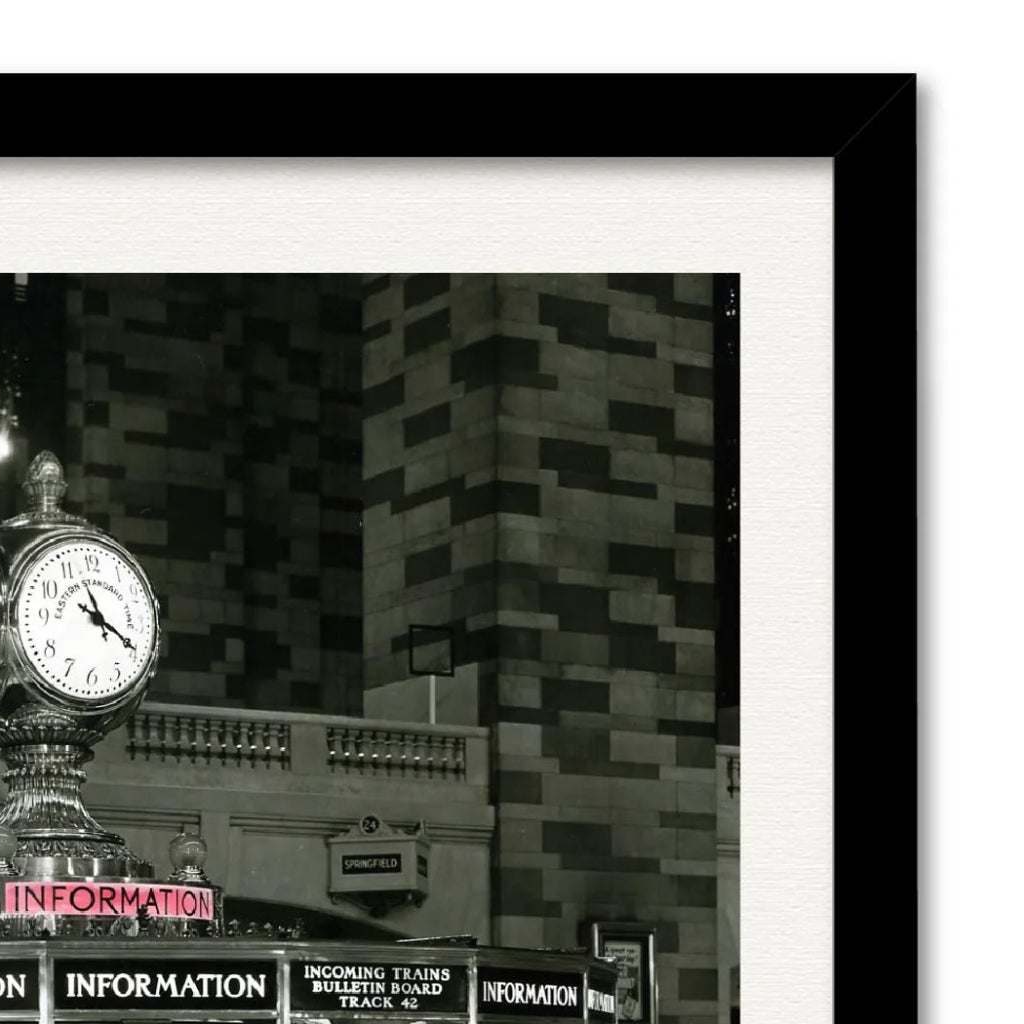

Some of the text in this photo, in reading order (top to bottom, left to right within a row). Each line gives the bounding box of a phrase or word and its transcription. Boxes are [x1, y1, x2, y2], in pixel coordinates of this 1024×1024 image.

[61, 561, 74, 579] 11
[84, 554, 100, 574] 12
[42, 579, 58, 600] 10
[54, 579, 135, 630] EASTERN STANDARD TIME
[38, 607, 50, 627] 9
[44, 638, 56, 659] 8
[64, 657, 76, 678] 7
[86, 666, 98, 688] 6
[109, 661, 121, 683] 5
[363, 819, 377, 831] 24
[344, 857, 398, 871] SPRINGFIELD
[14, 884, 211, 917] INFORMATION
[304, 966, 450, 981] INCOMING TRAINS
[67, 973, 266, 998] INFORMATION
[313, 981, 442, 995] BULLETIN BOARD
[484, 981, 577, 1006] INFORMATION
[339, 996, 418, 1009] TRACK 42
